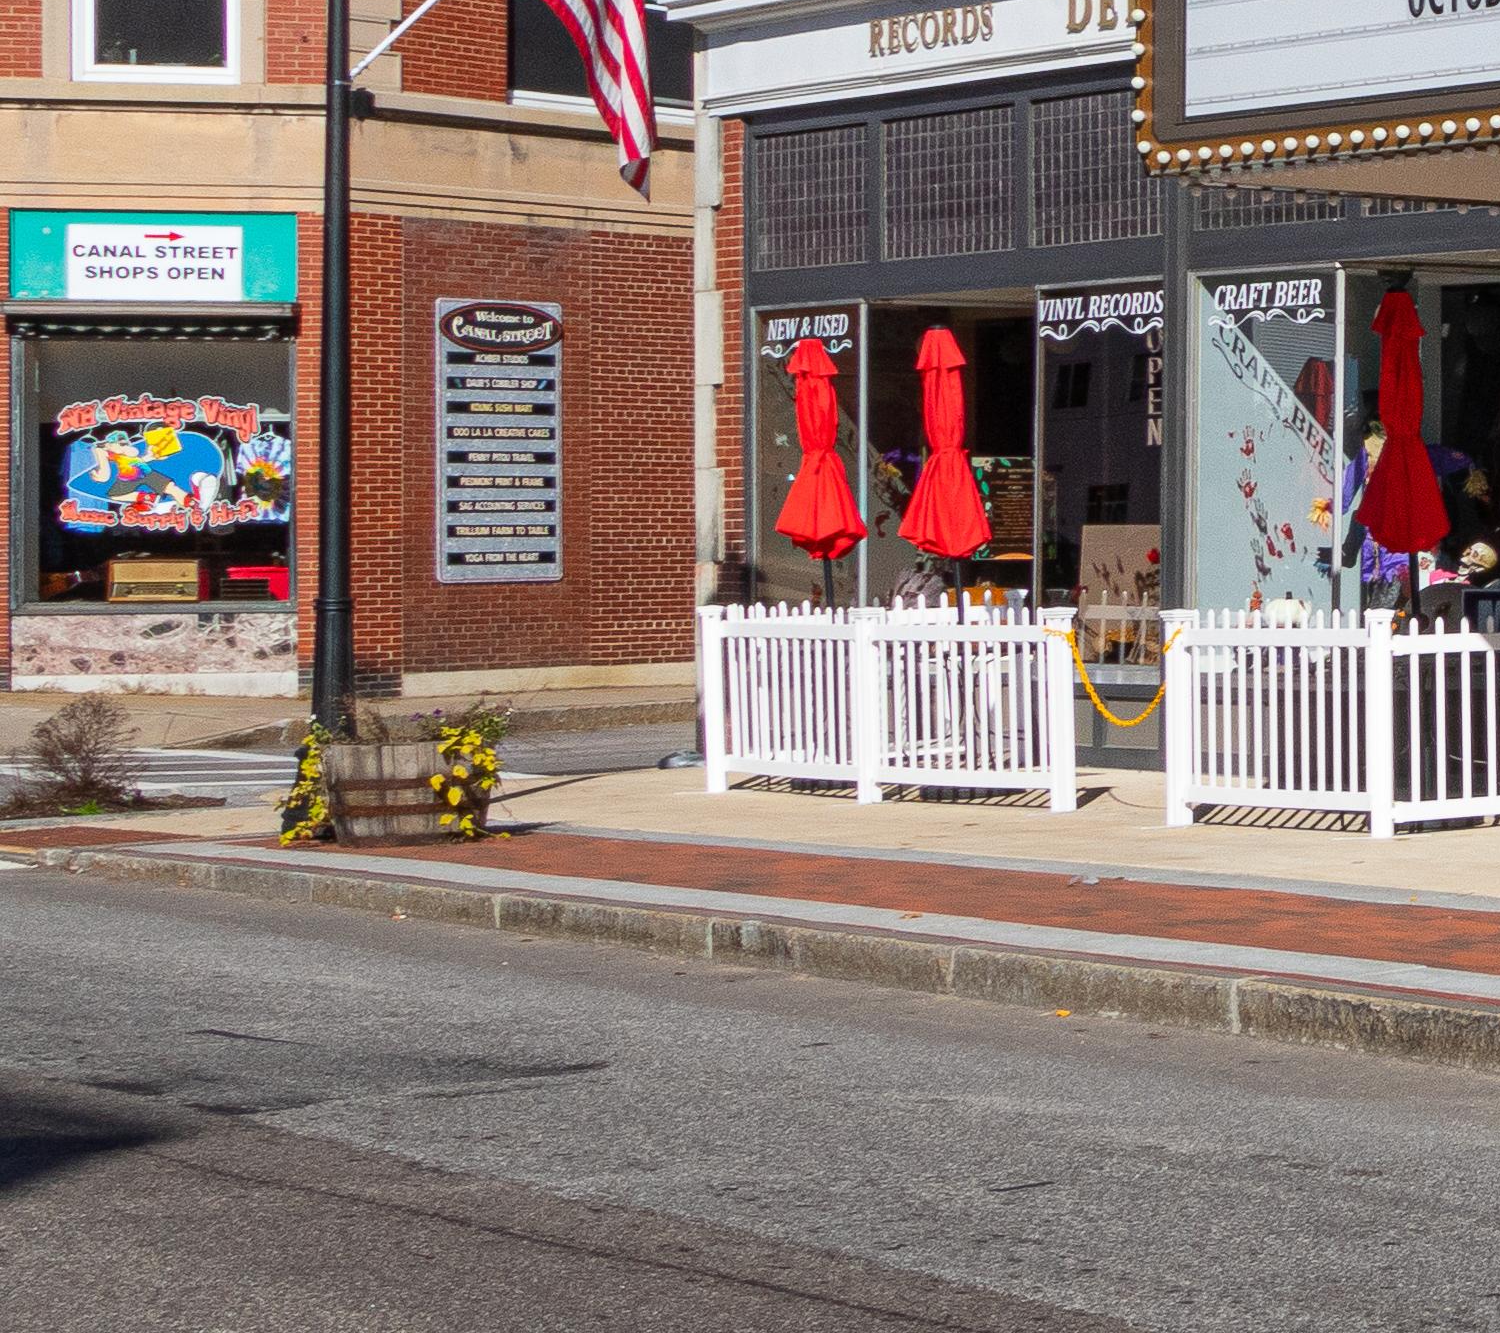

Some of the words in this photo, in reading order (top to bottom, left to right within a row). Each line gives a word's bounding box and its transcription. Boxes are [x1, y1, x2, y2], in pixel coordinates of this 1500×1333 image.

[868, 1, 994, 58] RECORDS
[72, 244, 146, 258] CANAL
[154, 245, 238, 260] STREET
[85, 265, 159, 279] SHOPS
[167, 267, 225, 281] OPEN
[1038, 295, 1085, 322] VINYL
[1088, 290, 1164, 319] RECORDS
[1214, 281, 1272, 311] CRAFT
[1274, 278, 1322, 307] BEER
[475, 311, 522, 324] Welcome
[523, 314, 535, 324] to
[767, 317, 800, 341] NEW
[800, 316, 811, 338] &
[814, 313, 849, 337] USED
[1146, 327, 1163, 446] OPEN
[102, 394, 198, 430] Vintage
[199, 397, 259, 443] Vinyl
[121, 504, 187, 531] Supply
